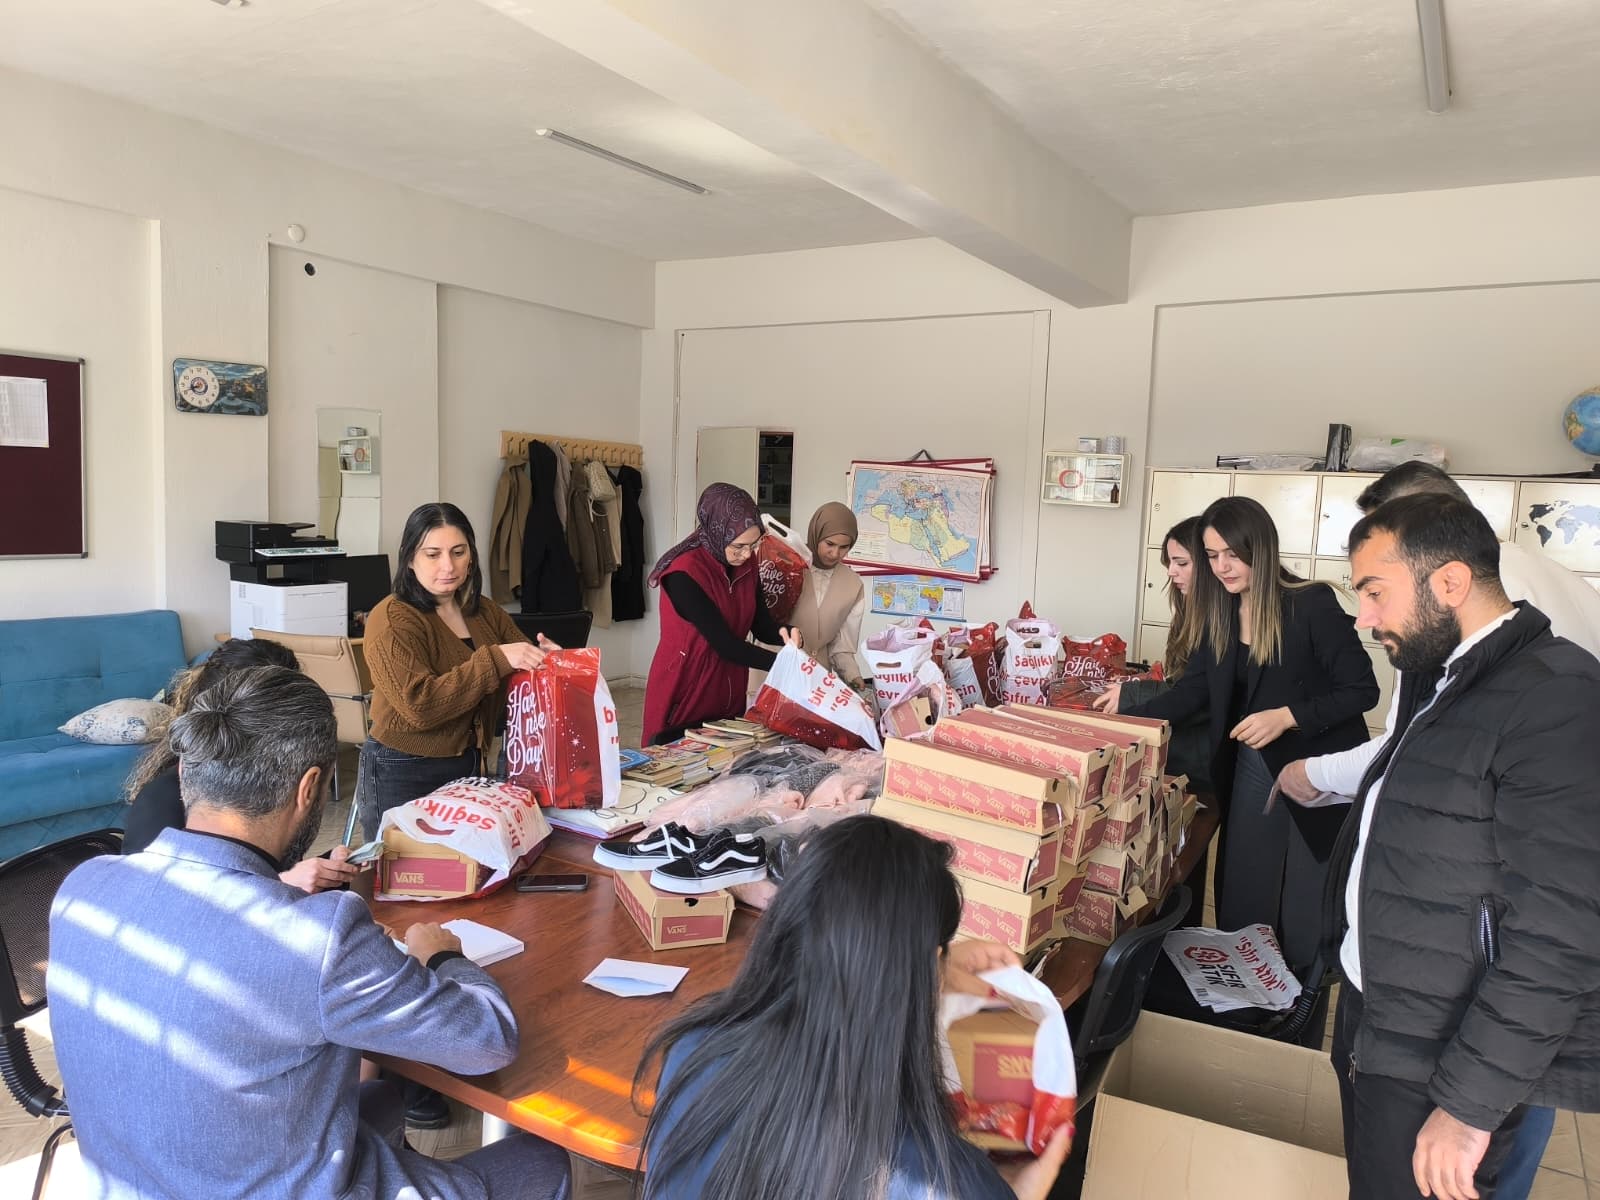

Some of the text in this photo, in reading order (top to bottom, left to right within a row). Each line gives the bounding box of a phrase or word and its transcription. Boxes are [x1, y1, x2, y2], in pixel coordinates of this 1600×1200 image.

[394, 871, 425, 884] VANS
[1090, 902, 1109, 920] VANS
[666, 924, 688, 935] VANS
[1217, 964, 1247, 989] SIFIR
